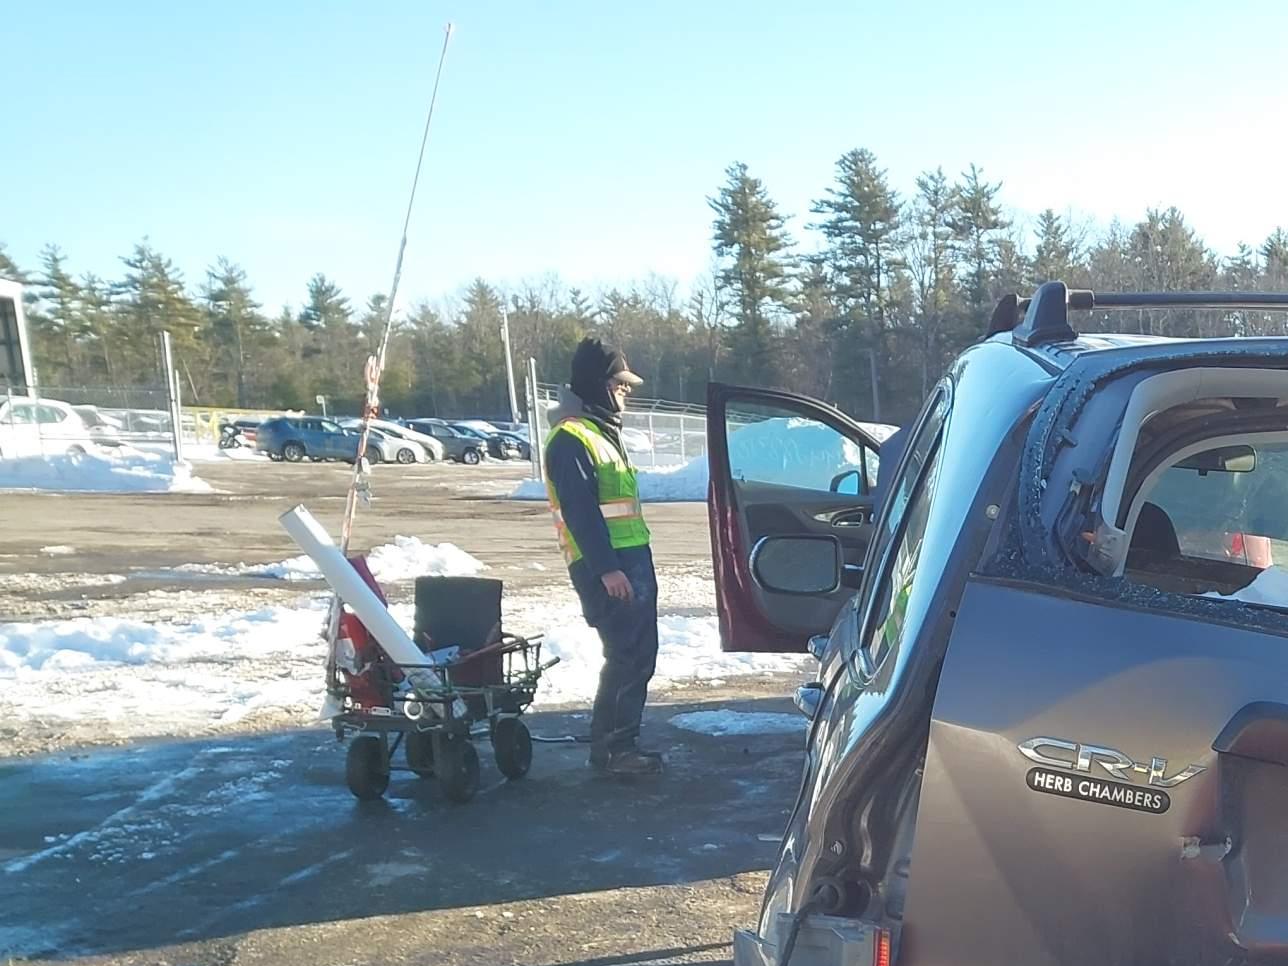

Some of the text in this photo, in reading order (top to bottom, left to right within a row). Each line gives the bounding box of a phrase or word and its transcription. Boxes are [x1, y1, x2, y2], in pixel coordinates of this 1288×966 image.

[1016, 736, 1208, 788] CR-V
[1034, 772, 1162, 809] HERB CHAMBERS
